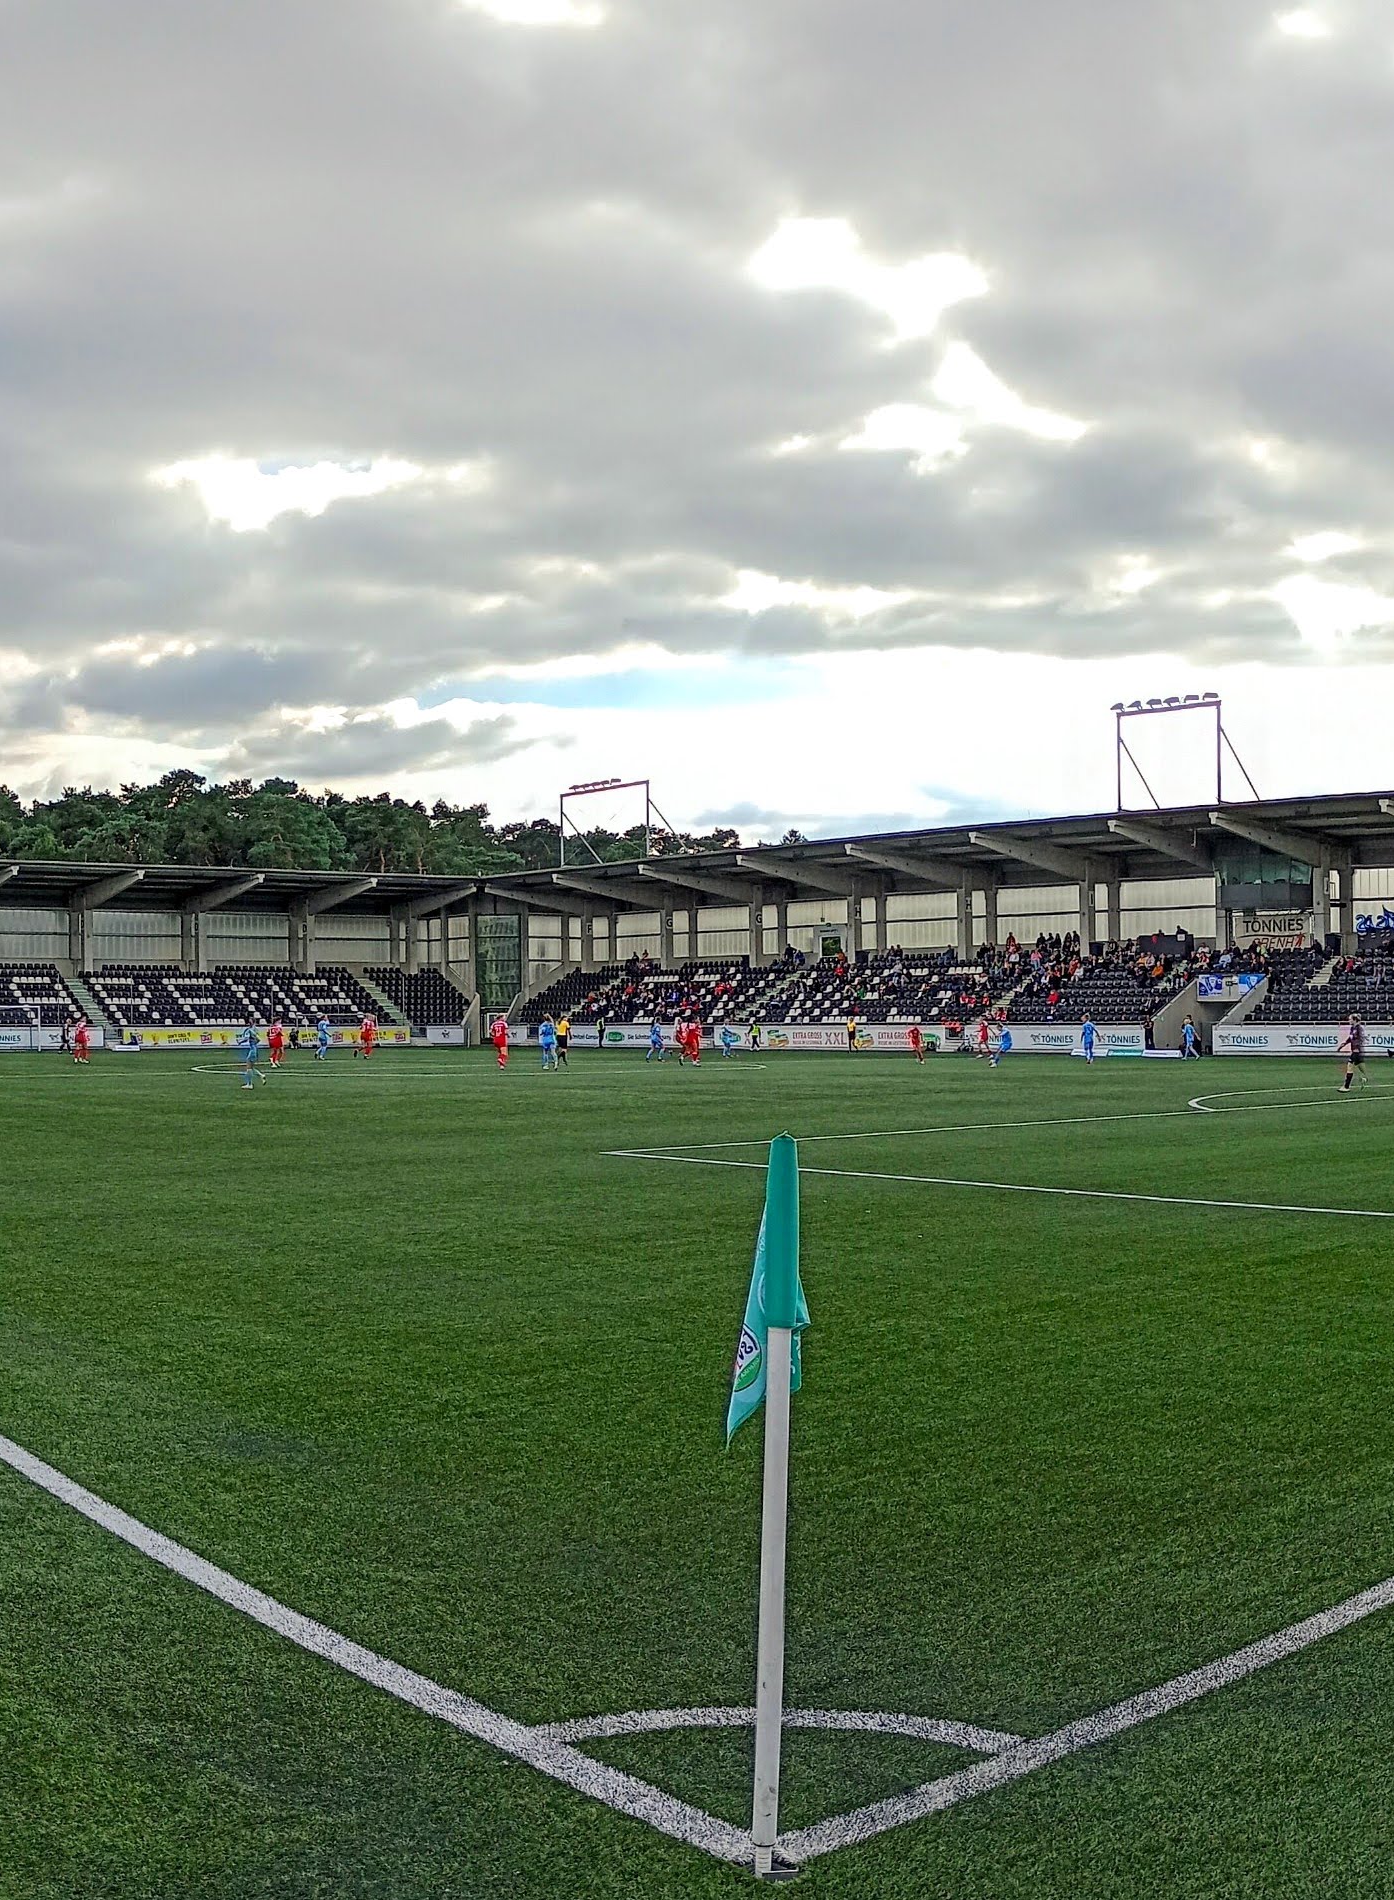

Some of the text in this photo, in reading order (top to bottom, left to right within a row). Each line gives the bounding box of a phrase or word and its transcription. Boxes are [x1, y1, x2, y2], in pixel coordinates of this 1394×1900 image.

[666, 917, 673, 928] G
[1243, 916, 1304, 933] TÖNNIES
[824, 1031, 848, 1045] XXL
[1041, 1033, 1074, 1044] TÖNNIES
[1106, 1034, 1141, 1044] TÖNNIES
[1231, 1034, 1269, 1045] TÖNNIES
[1299, 1034, 1339, 1045] TÖNNIES
